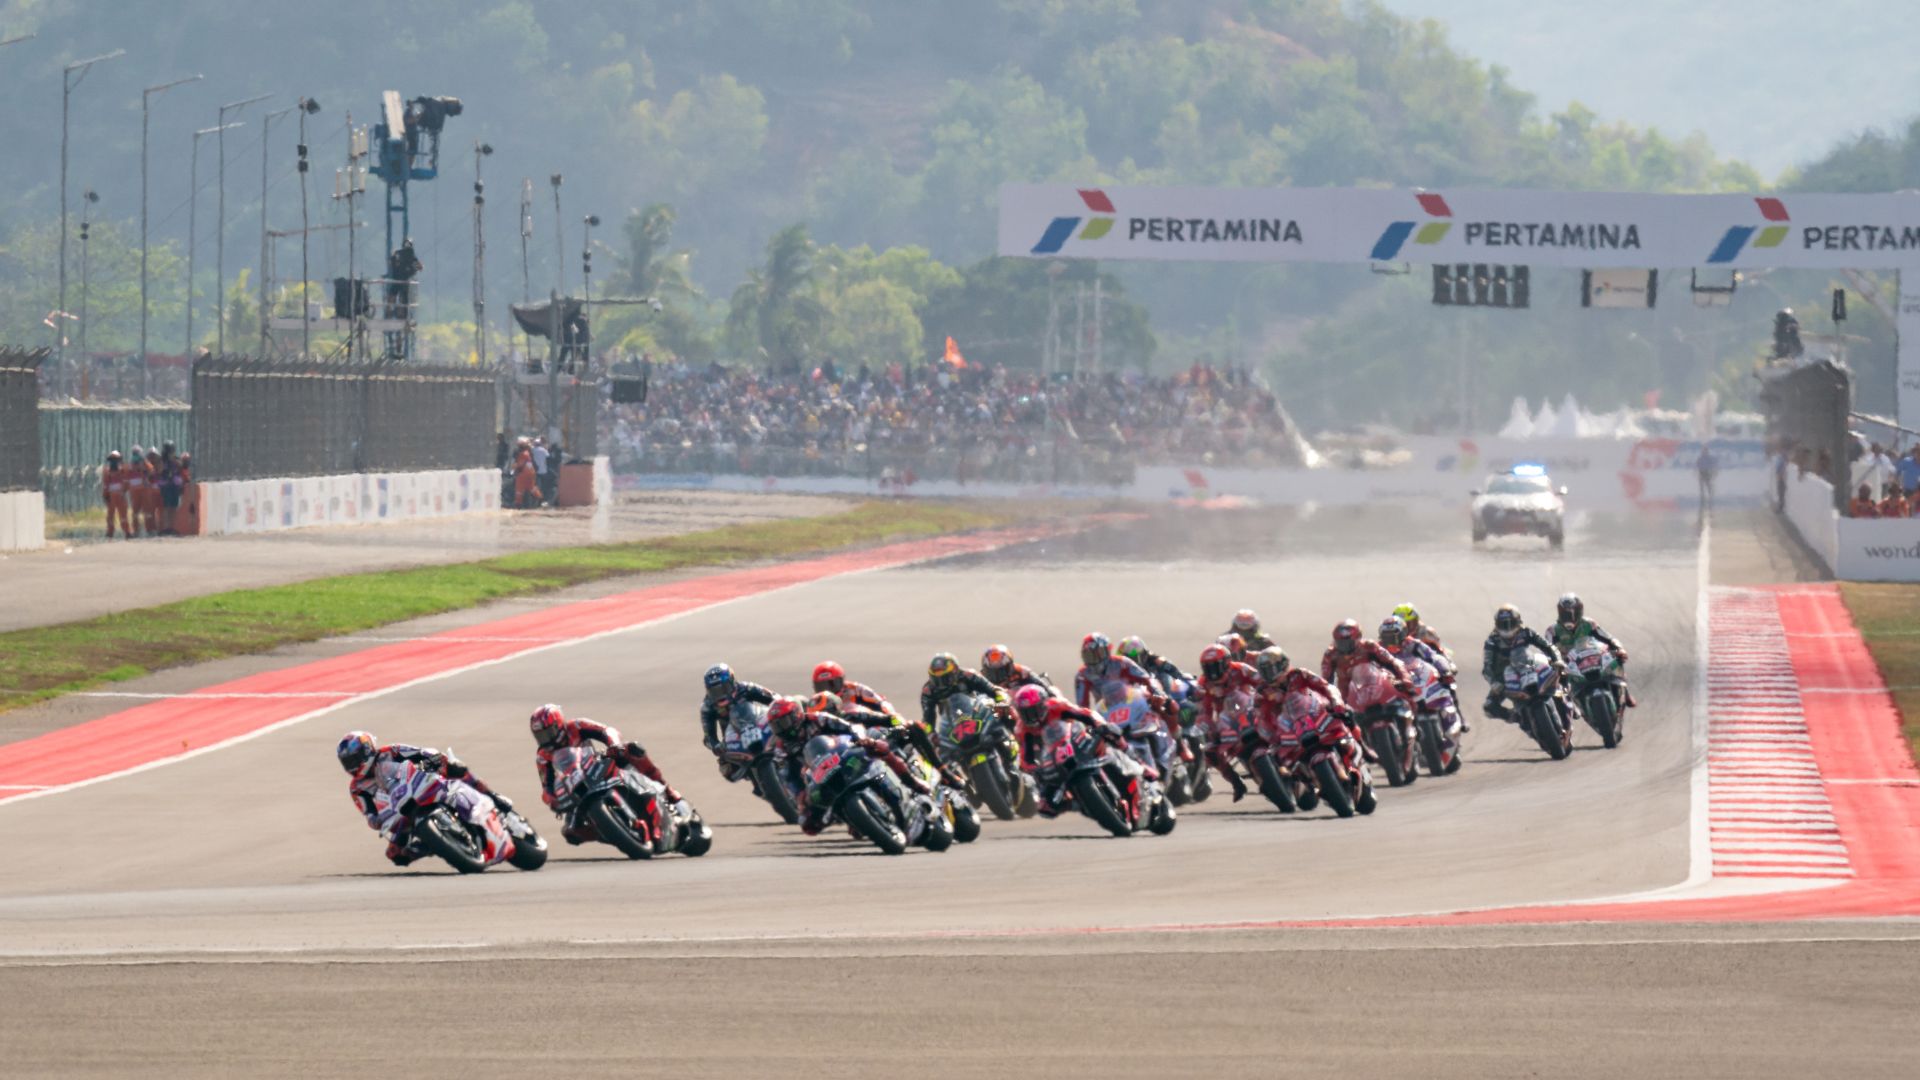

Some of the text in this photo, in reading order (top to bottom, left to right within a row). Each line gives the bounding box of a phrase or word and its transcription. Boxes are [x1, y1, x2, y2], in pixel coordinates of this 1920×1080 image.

[1129, 217, 1303, 244] PERTAMINA
[1464, 221, 1642, 249] PERTAMINA
[1803, 224, 1920, 250] PERTAM
[1863, 540, 1920, 560] wond
